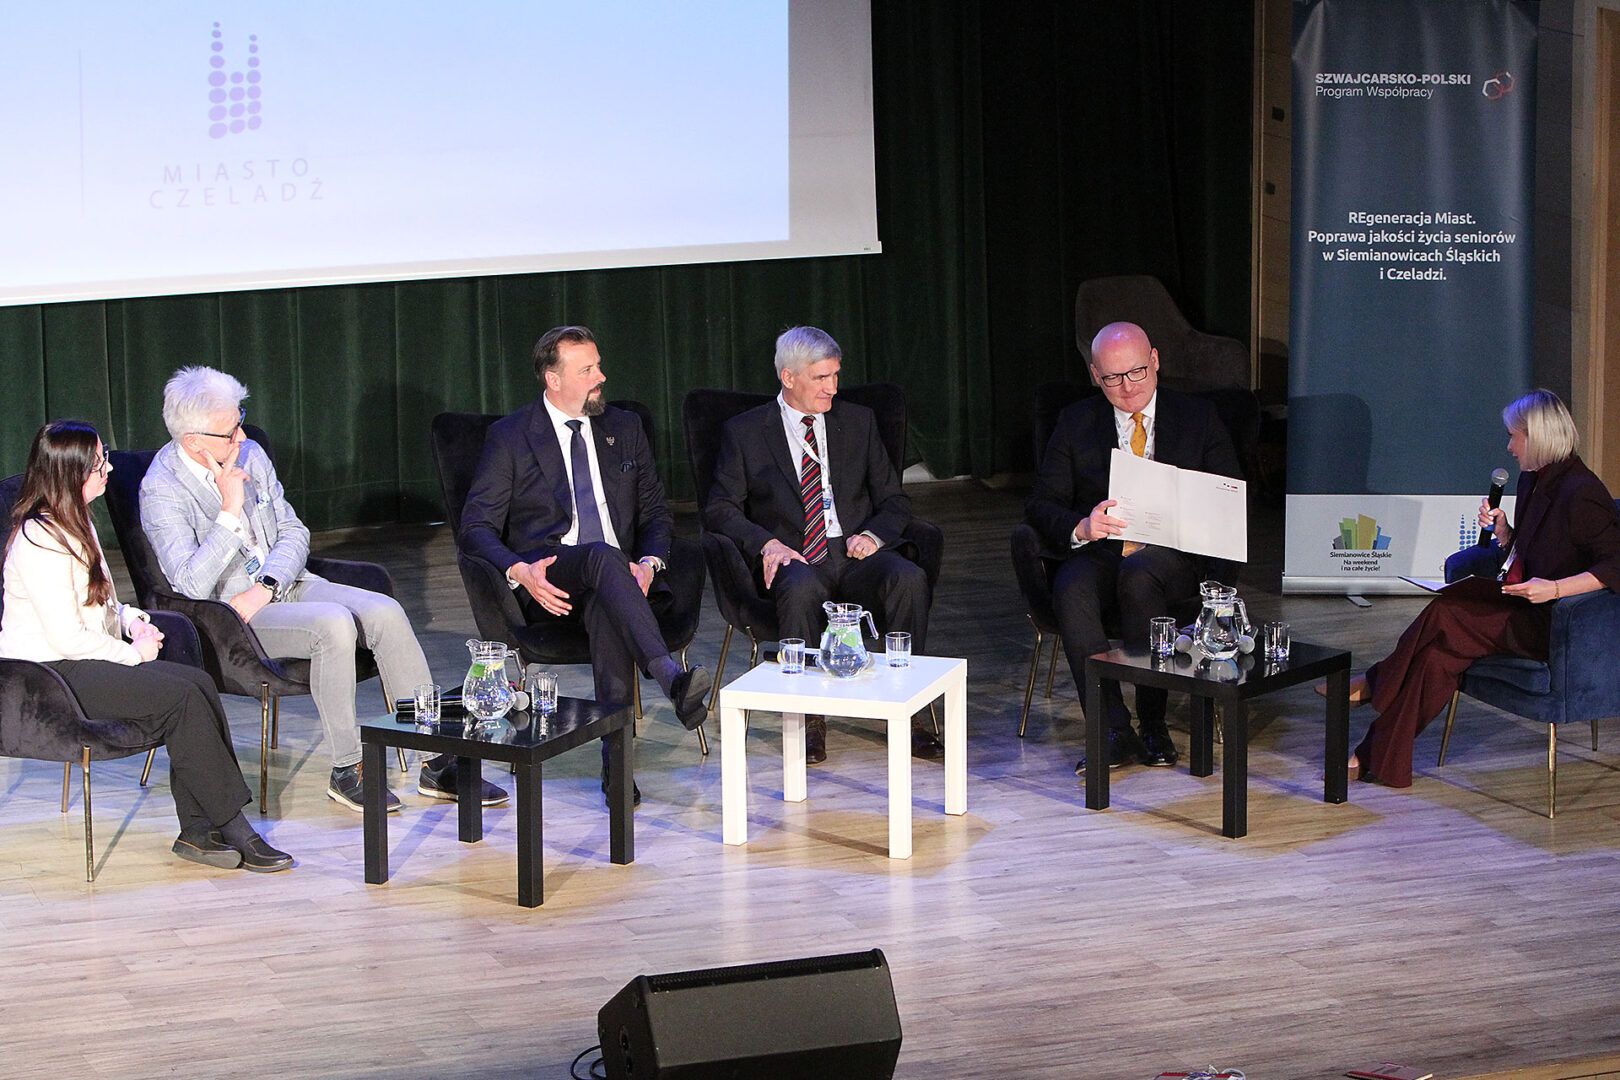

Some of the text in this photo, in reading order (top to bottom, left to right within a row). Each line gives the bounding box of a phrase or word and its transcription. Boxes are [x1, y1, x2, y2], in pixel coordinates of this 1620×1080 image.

[1315, 73, 1471, 85] SZWAJCARSKO-POLSKI
[1315, 86, 1434, 100] Program Współpracy
[164, 157, 309, 184] MIASTO
[1348, 211, 1476, 227] REgeneracja Miast.
[1308, 230, 1516, 246] Poprawa jakości życia seniorów
[1322, 247, 1501, 265] w Siemianowicach Śląskich
[1379, 267, 1447, 281] i Czeladzi.
[1371, 551, 1392, 559] Śląskie
